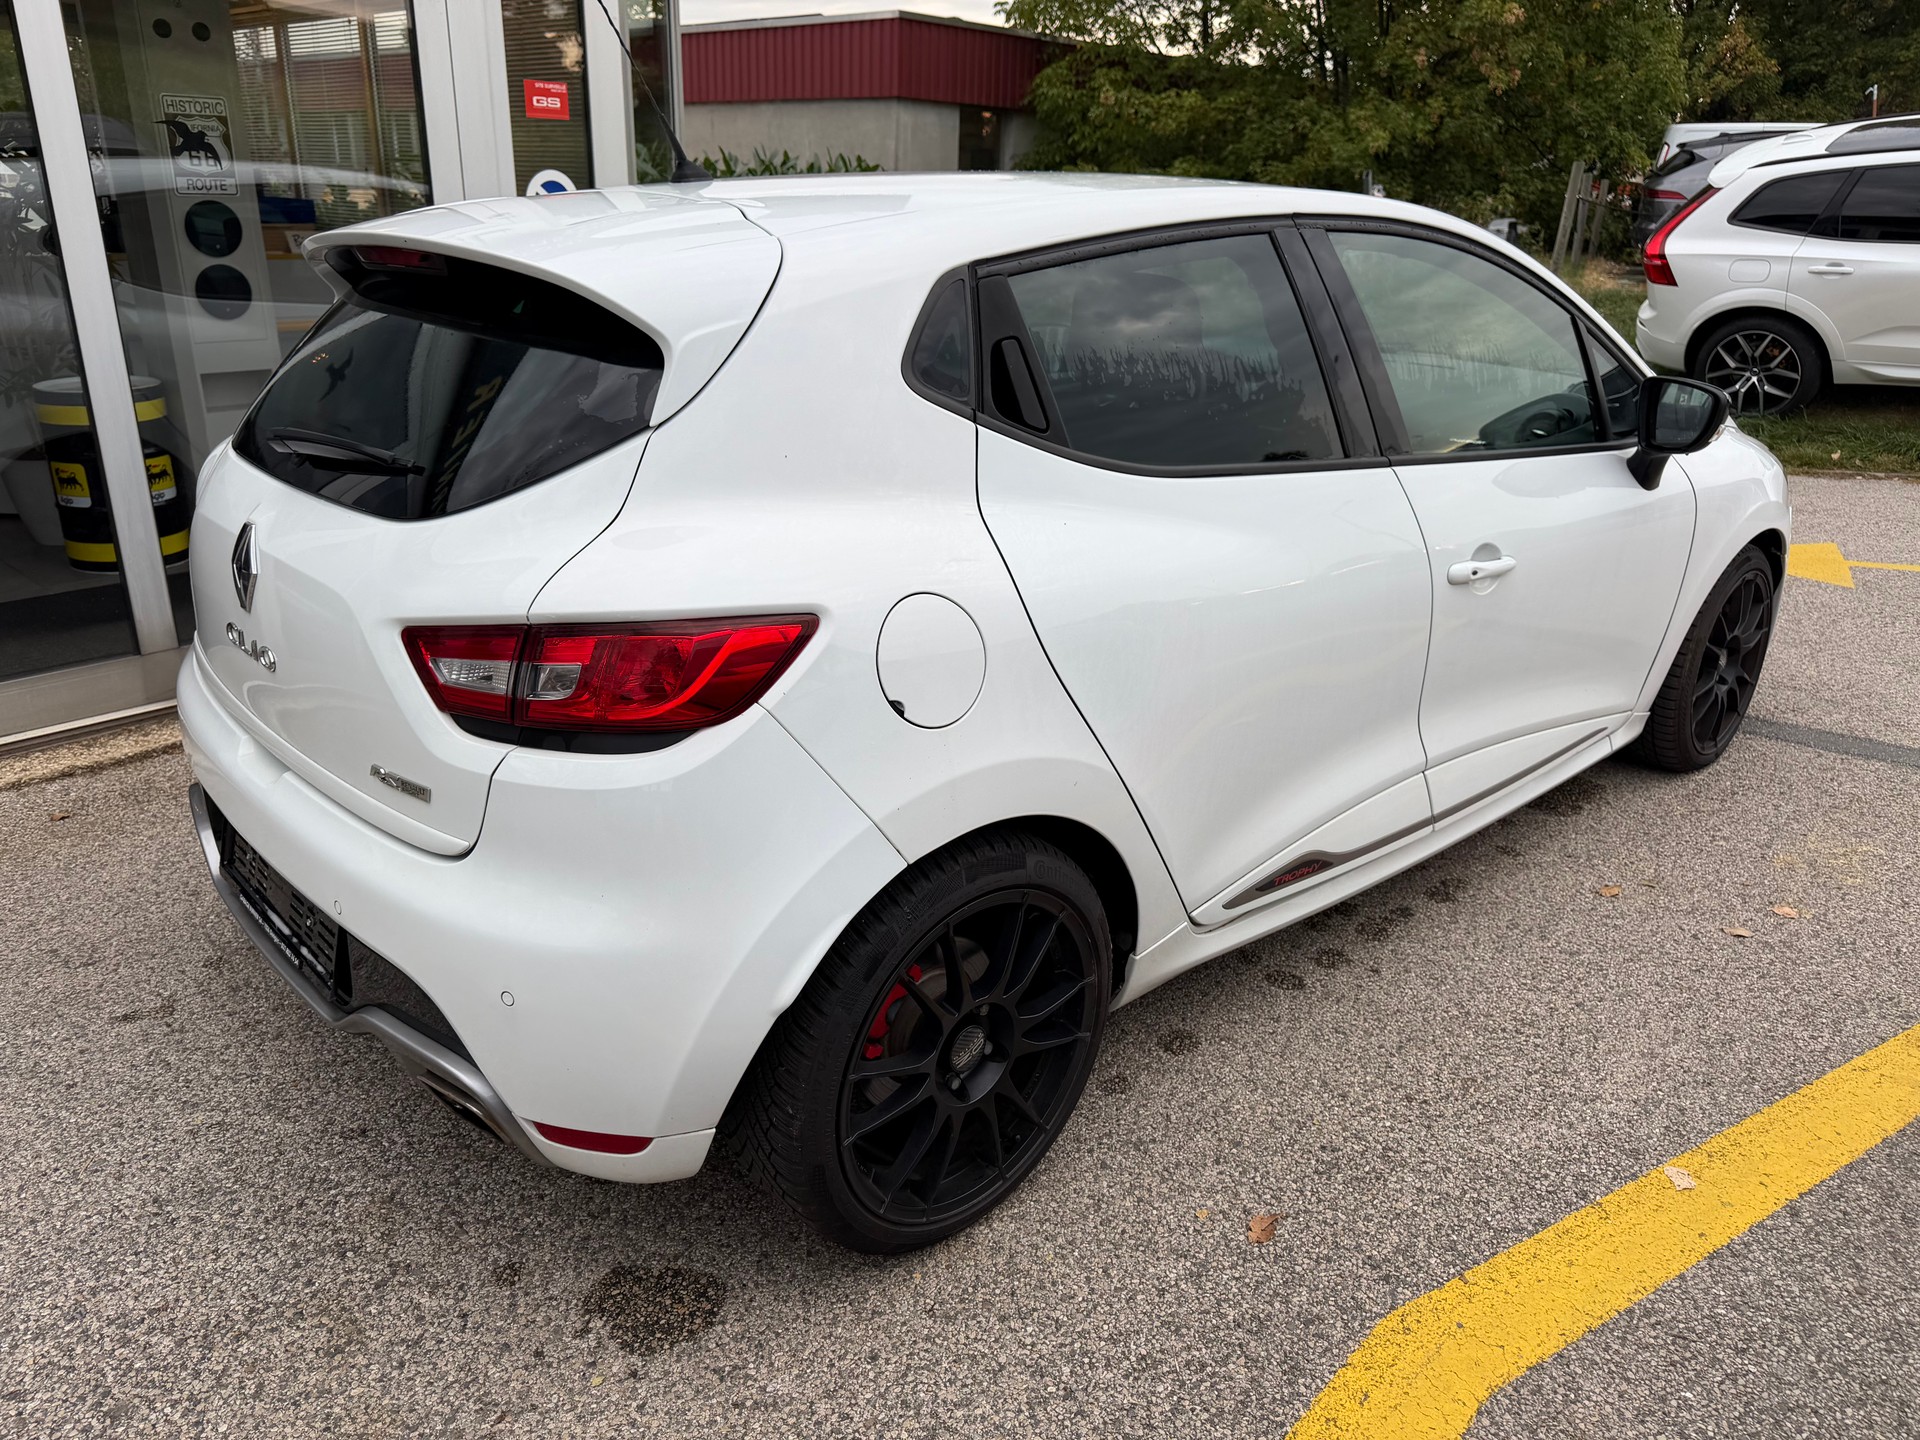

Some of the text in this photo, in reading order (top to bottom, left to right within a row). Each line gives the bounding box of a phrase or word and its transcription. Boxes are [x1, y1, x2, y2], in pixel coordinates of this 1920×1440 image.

[165, 99, 223, 114] HISTORIC
[532, 96, 561, 108] GS
[186, 178, 228, 191] ROUTE
[226, 621, 276, 672] CLIO
[1273, 860, 1323, 886] TROPHY
